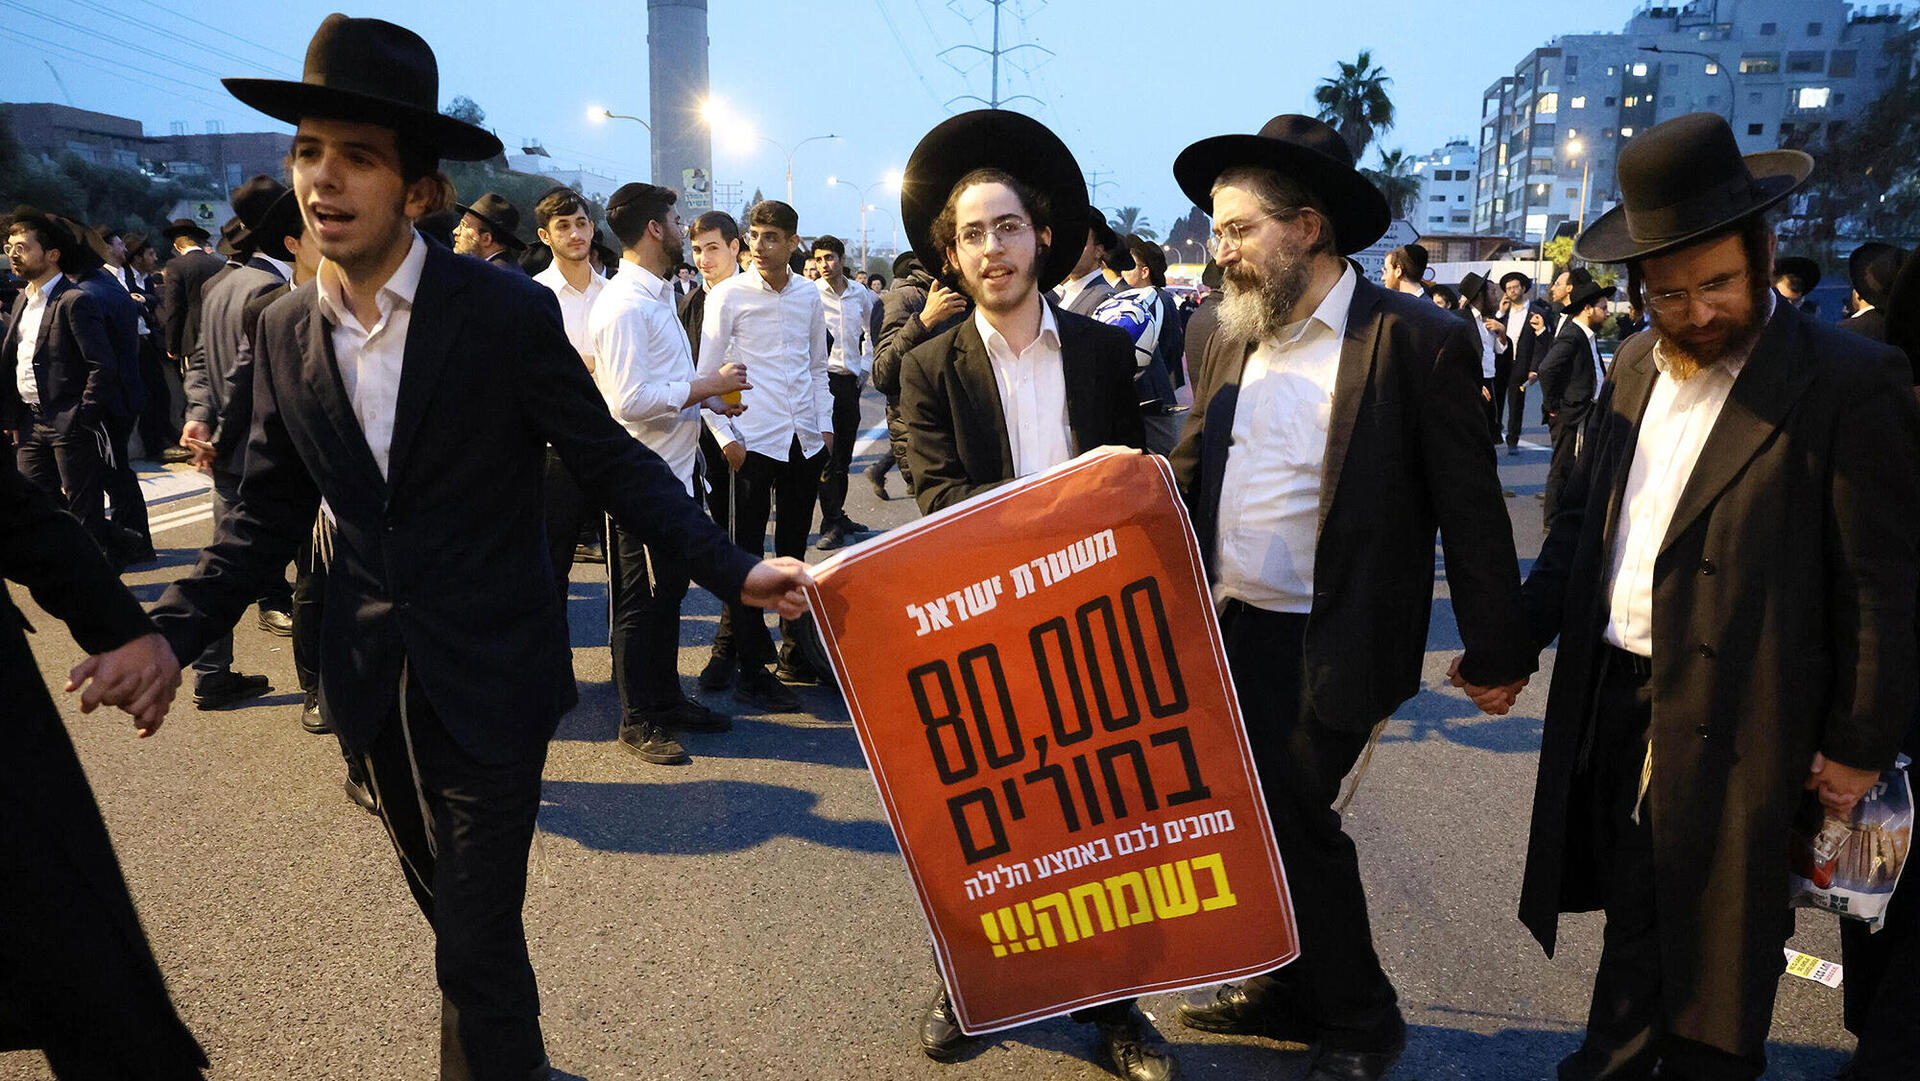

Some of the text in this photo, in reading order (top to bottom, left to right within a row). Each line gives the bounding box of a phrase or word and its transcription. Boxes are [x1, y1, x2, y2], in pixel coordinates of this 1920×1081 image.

[905, 528, 1118, 637] משטרת ישראל
[907, 575, 1190, 786] 80,000
[946, 725, 1212, 866] בחורים
[963, 809, 1236, 901] מחכים לכם באמצע הלילה
[980, 852, 1238, 958] בשמחה!!!
